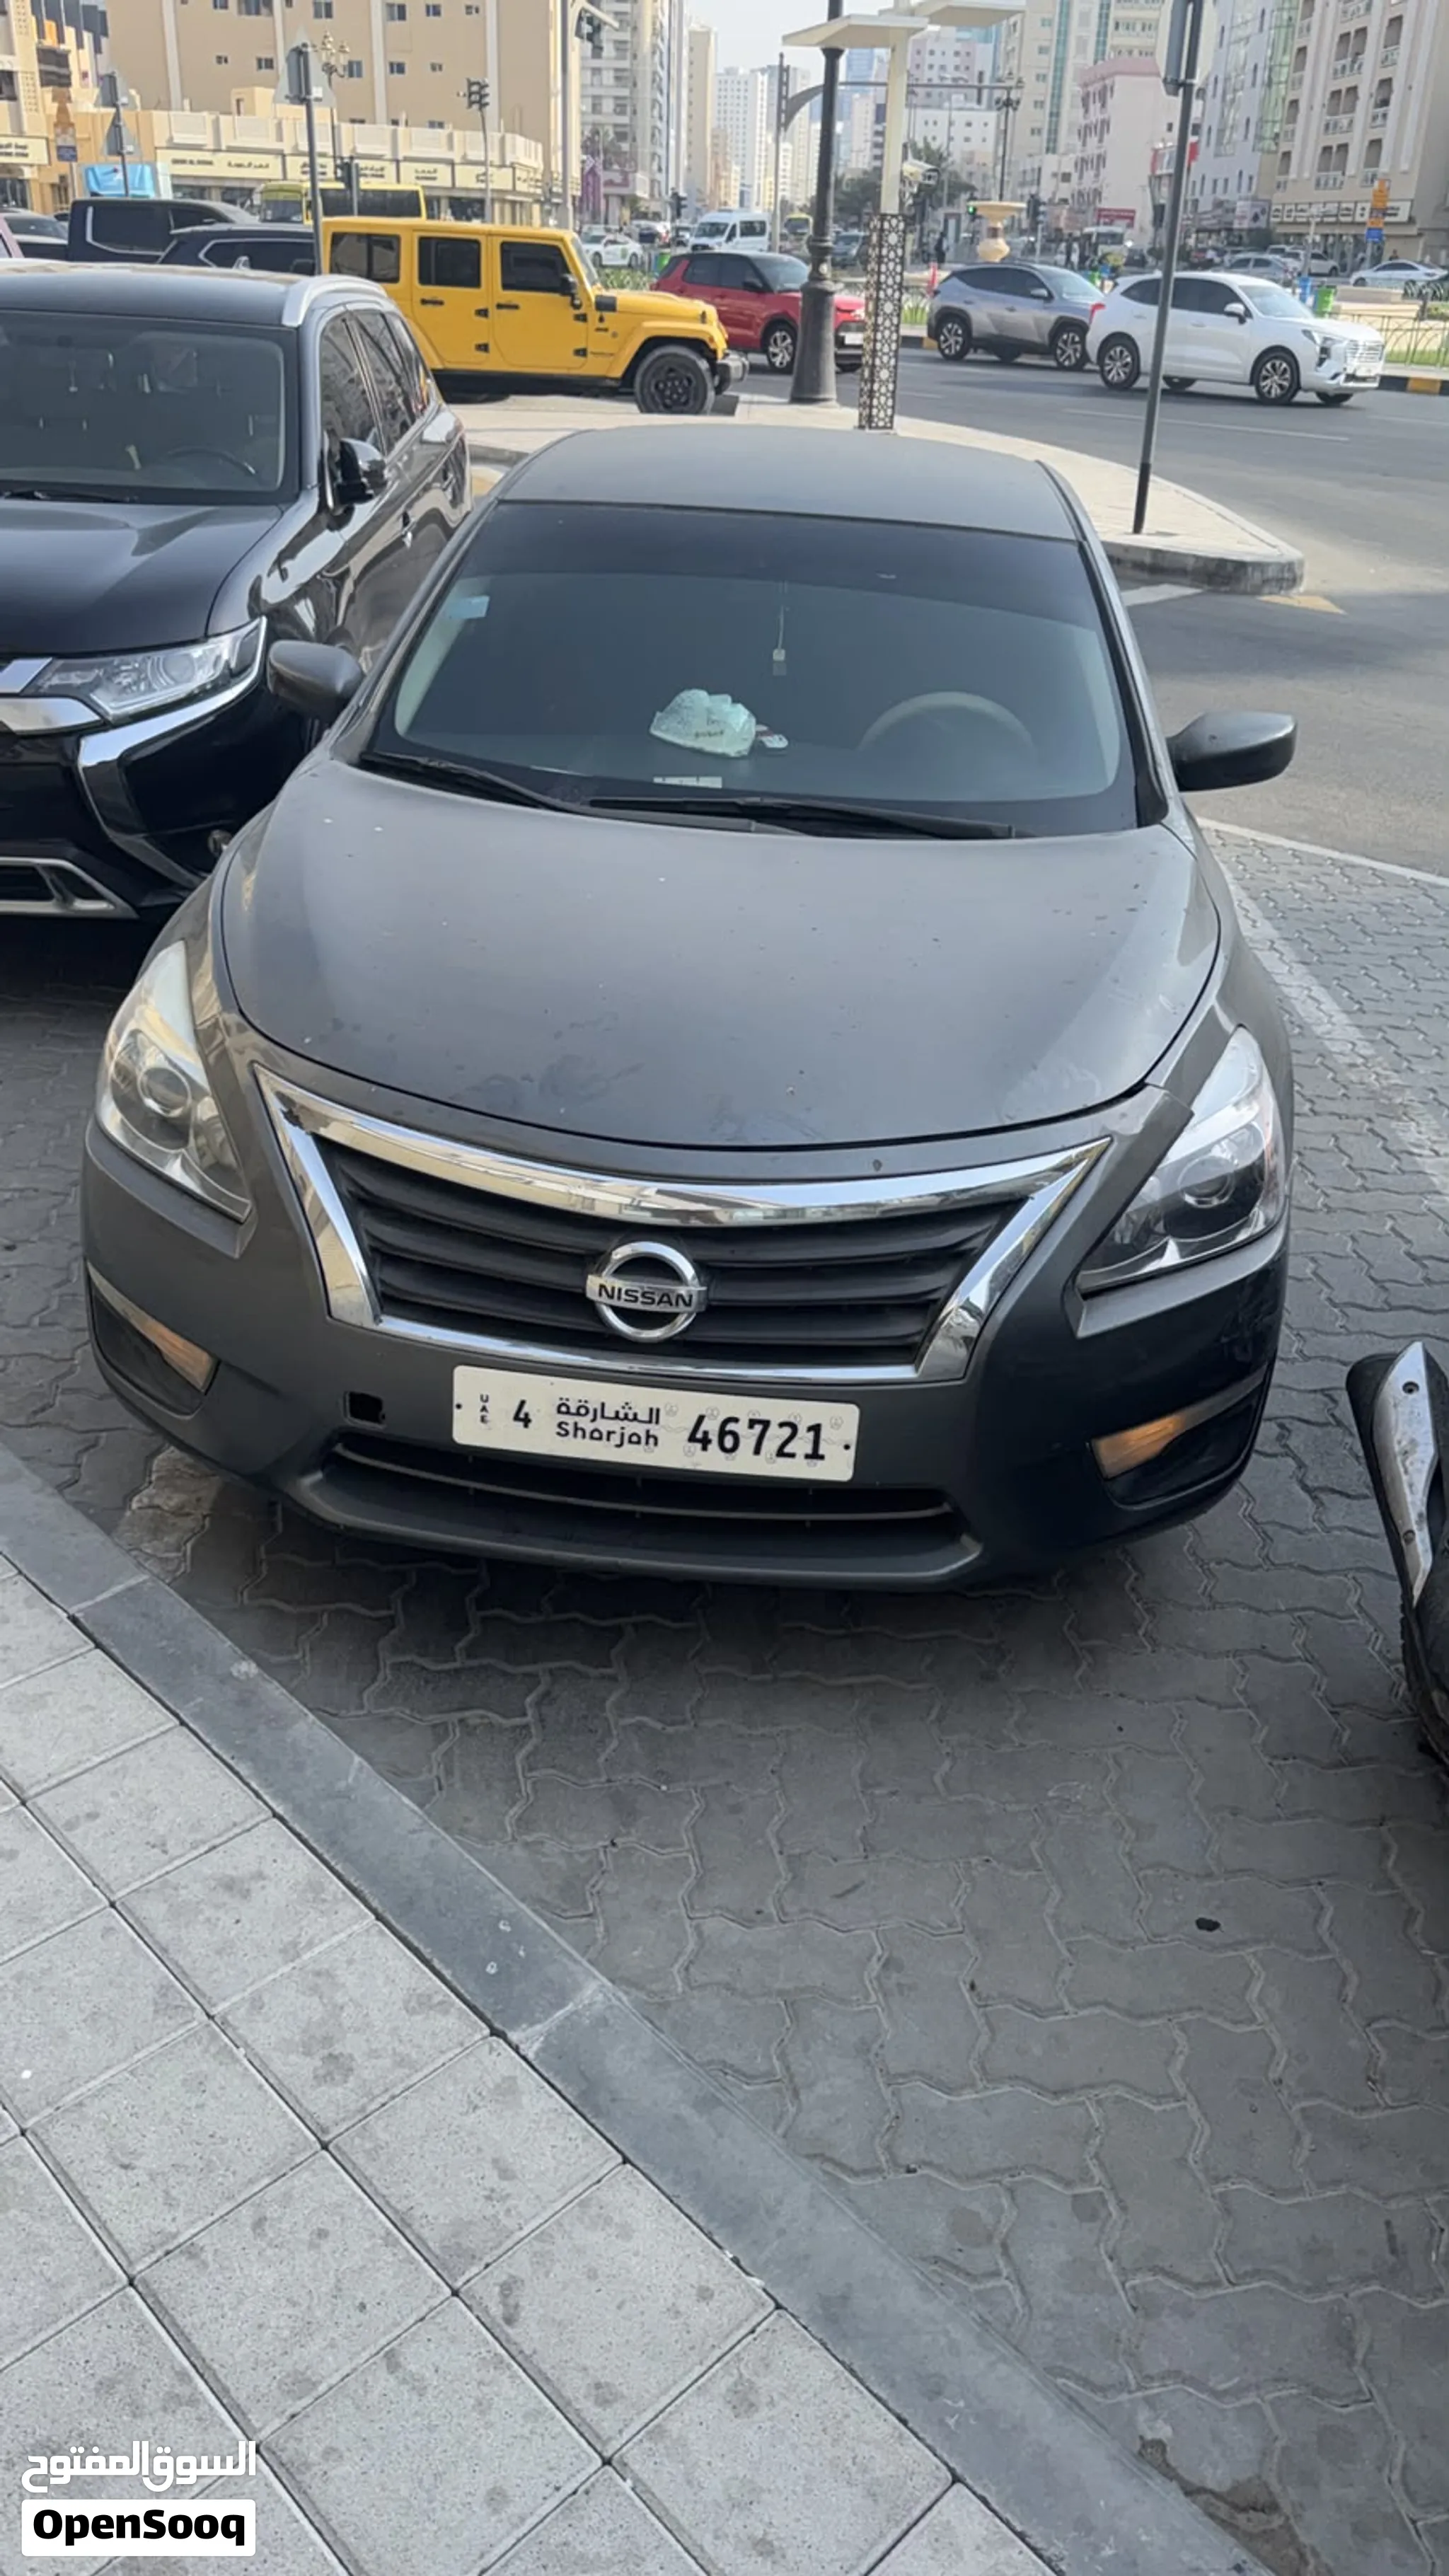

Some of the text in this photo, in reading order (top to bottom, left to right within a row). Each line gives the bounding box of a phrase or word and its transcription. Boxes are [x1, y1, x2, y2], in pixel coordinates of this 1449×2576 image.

[598, 1283, 693, 1307] NISSAN
[513, 1399, 532, 1428] 4
[556, 1397, 660, 1425] الشارقة
[555, 1421, 659, 1448] Sharjah
[688, 1414, 825, 1460] 46721
